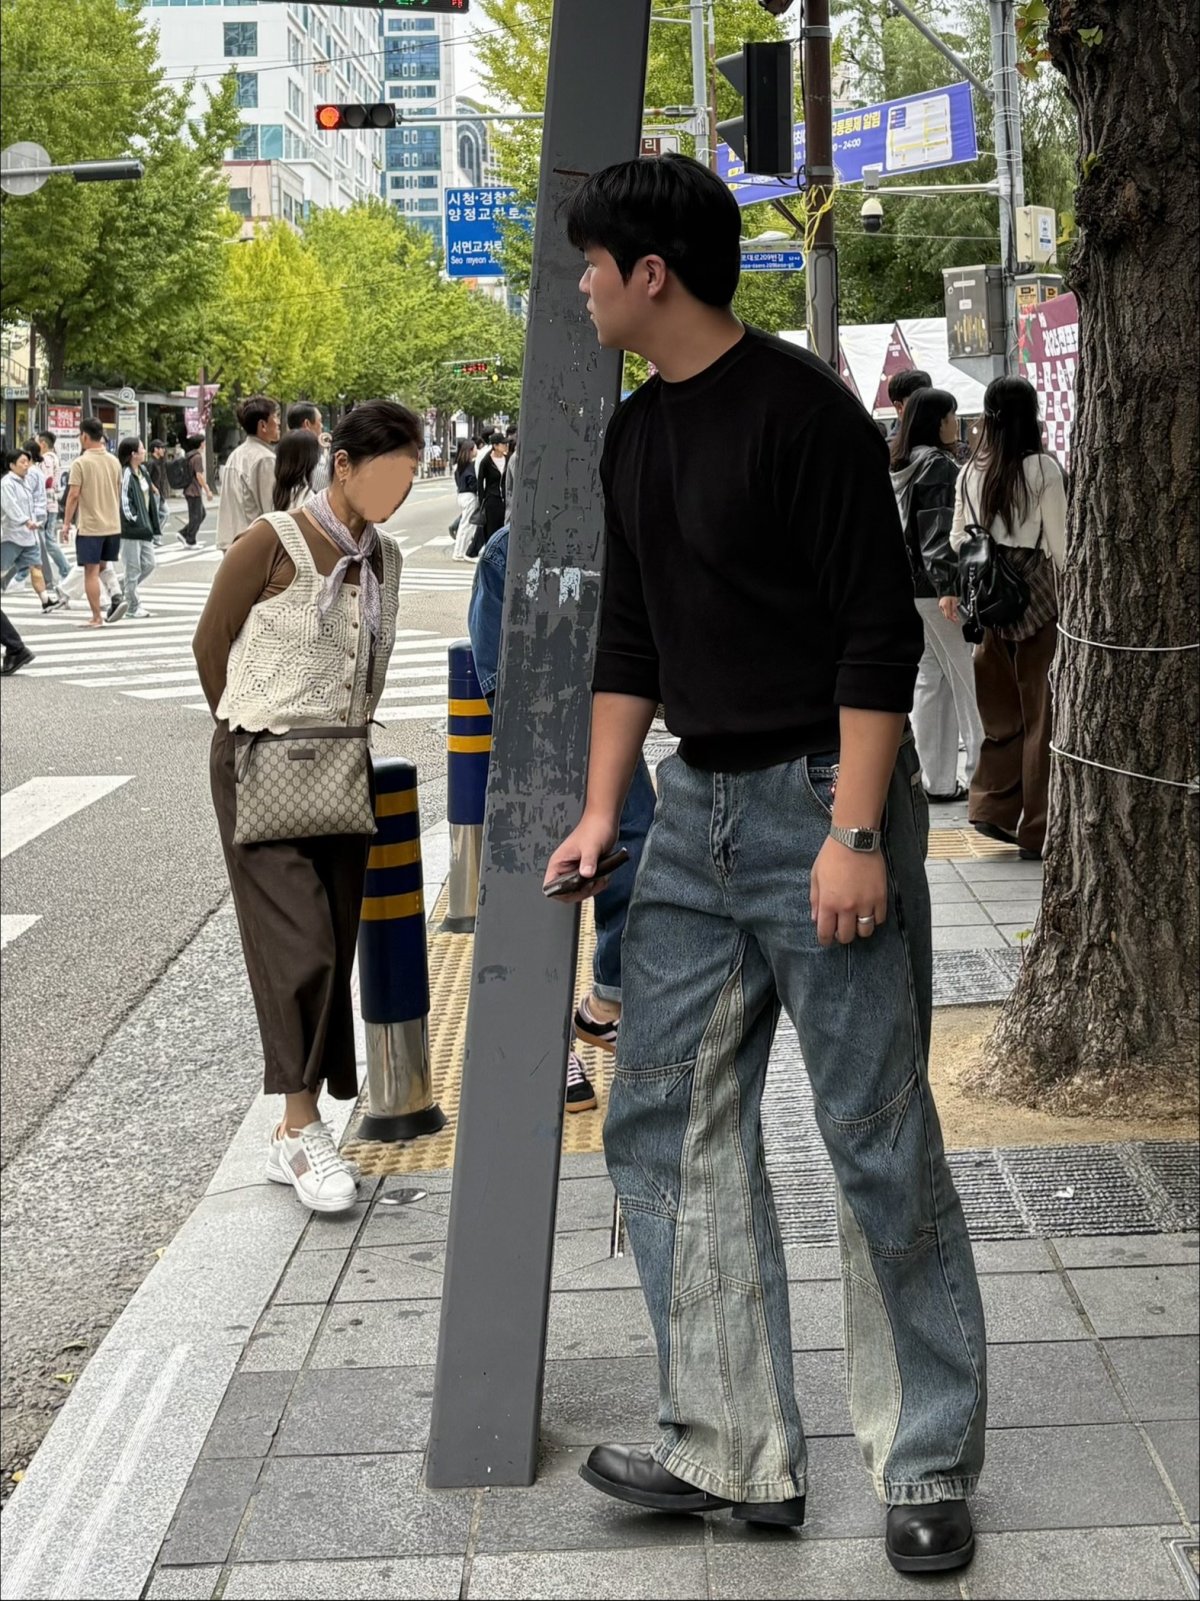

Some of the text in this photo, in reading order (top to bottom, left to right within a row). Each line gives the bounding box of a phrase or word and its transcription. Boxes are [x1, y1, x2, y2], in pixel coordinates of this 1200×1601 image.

[863, 110, 881, 130] 알림
[450, 255, 463, 265] Seo
[466, 256, 487, 266] myeon
